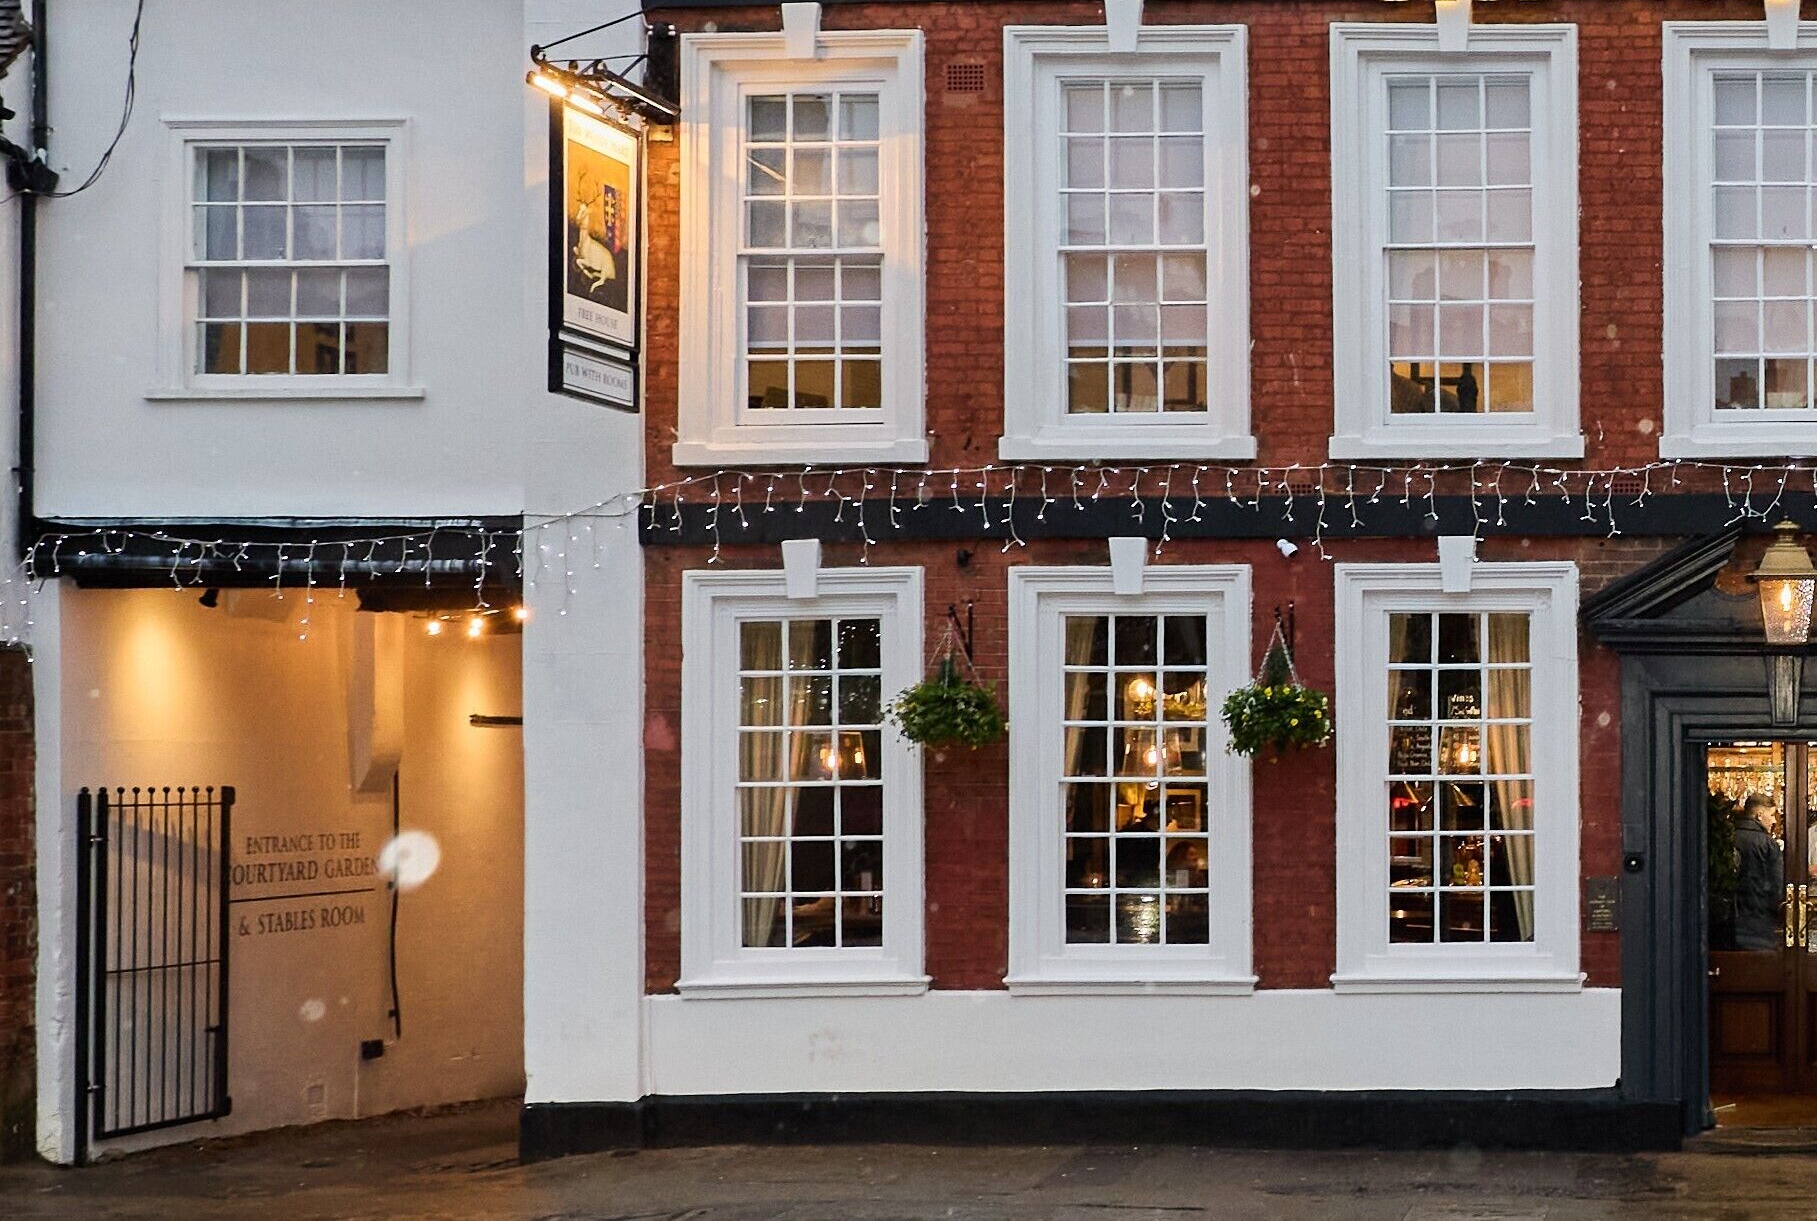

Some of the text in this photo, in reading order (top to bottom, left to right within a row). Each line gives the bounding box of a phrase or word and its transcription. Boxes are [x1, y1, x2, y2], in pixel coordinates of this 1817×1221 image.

[577, 307, 618, 330] FREE HOUSE
[566, 361, 628, 390] PUB WITH ROOMS
[246, 832, 360, 854] ENTRANCE TO THE
[228, 860, 318, 885] OURTYARD
[239, 906, 365, 936] & STABLES ROOM
